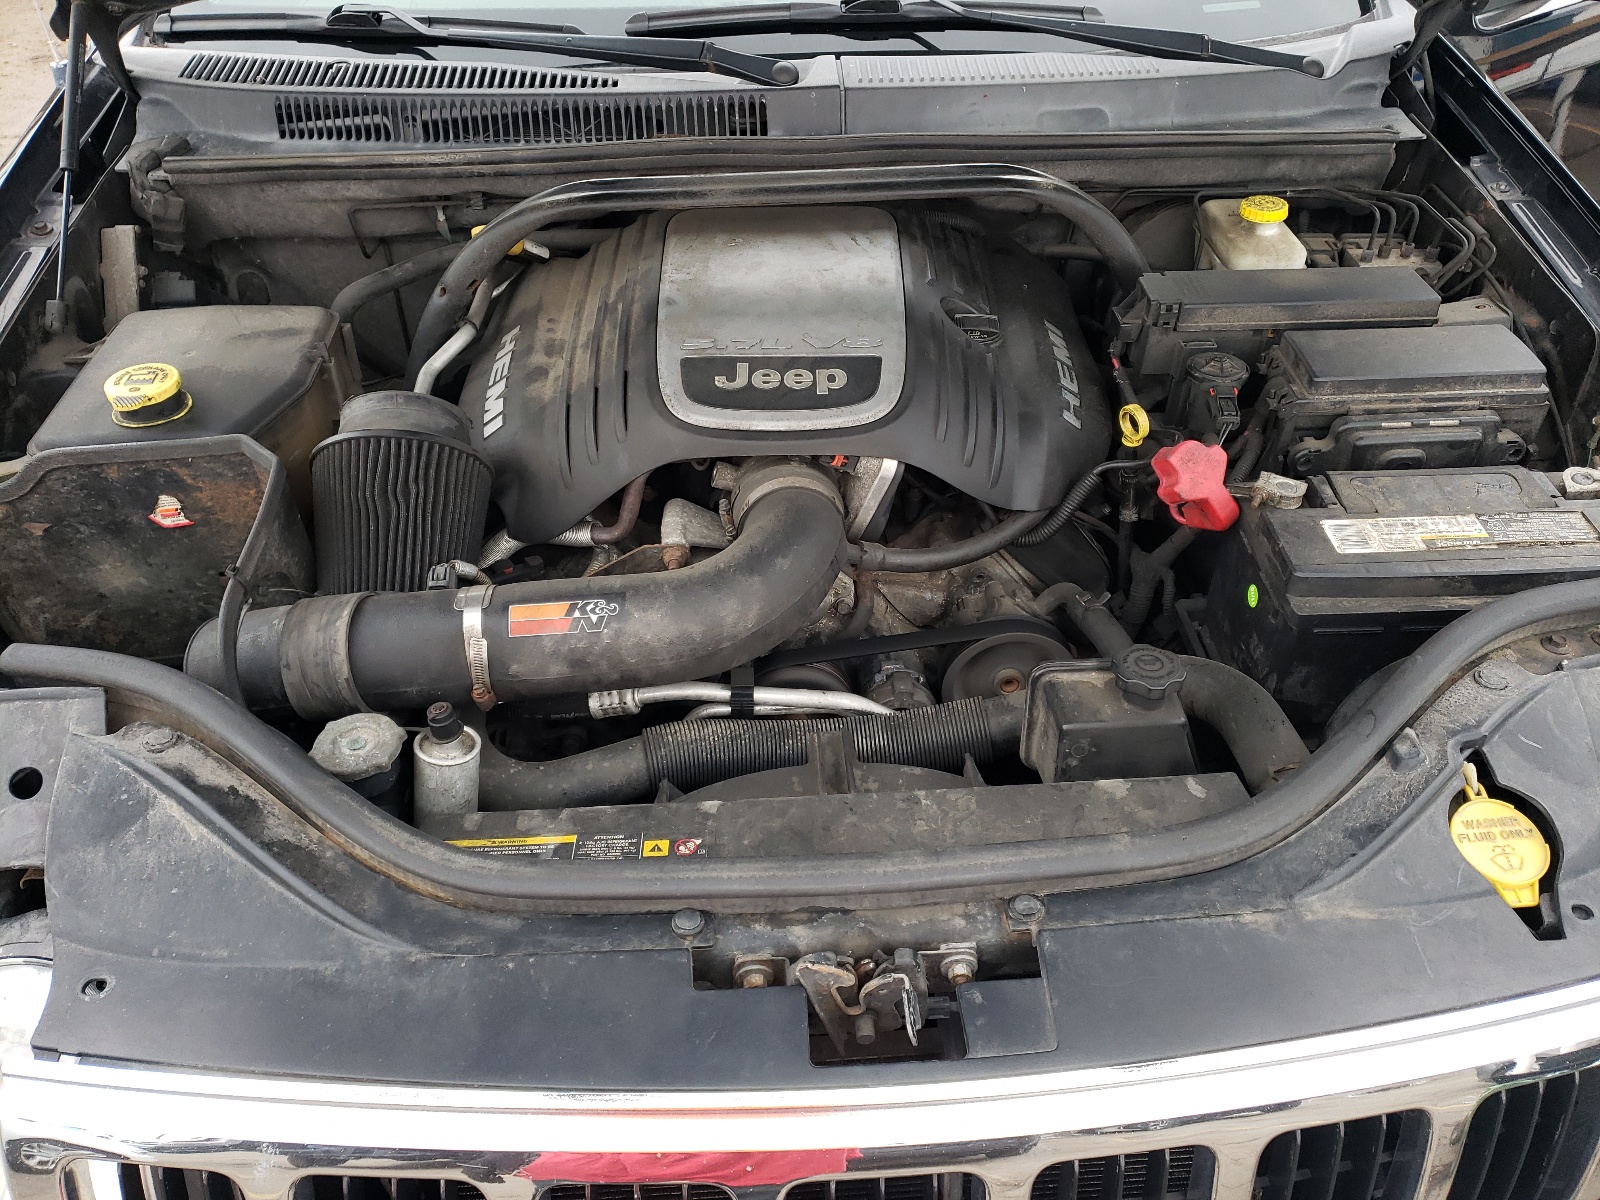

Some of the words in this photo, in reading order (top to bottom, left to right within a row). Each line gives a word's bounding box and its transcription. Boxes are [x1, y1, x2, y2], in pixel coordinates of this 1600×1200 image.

[680, 337, 793, 350] 5.7L
[801, 333, 883, 349] V8
[483, 325, 520, 439] HEMI
[714, 362, 848, 394] Jeep
[1044, 319, 1082, 429] HEMI
[1461, 816, 1522, 830] WASHER
[1457, 831, 1497, 843] FLUID
[1499, 828, 1534, 840] ONLY
